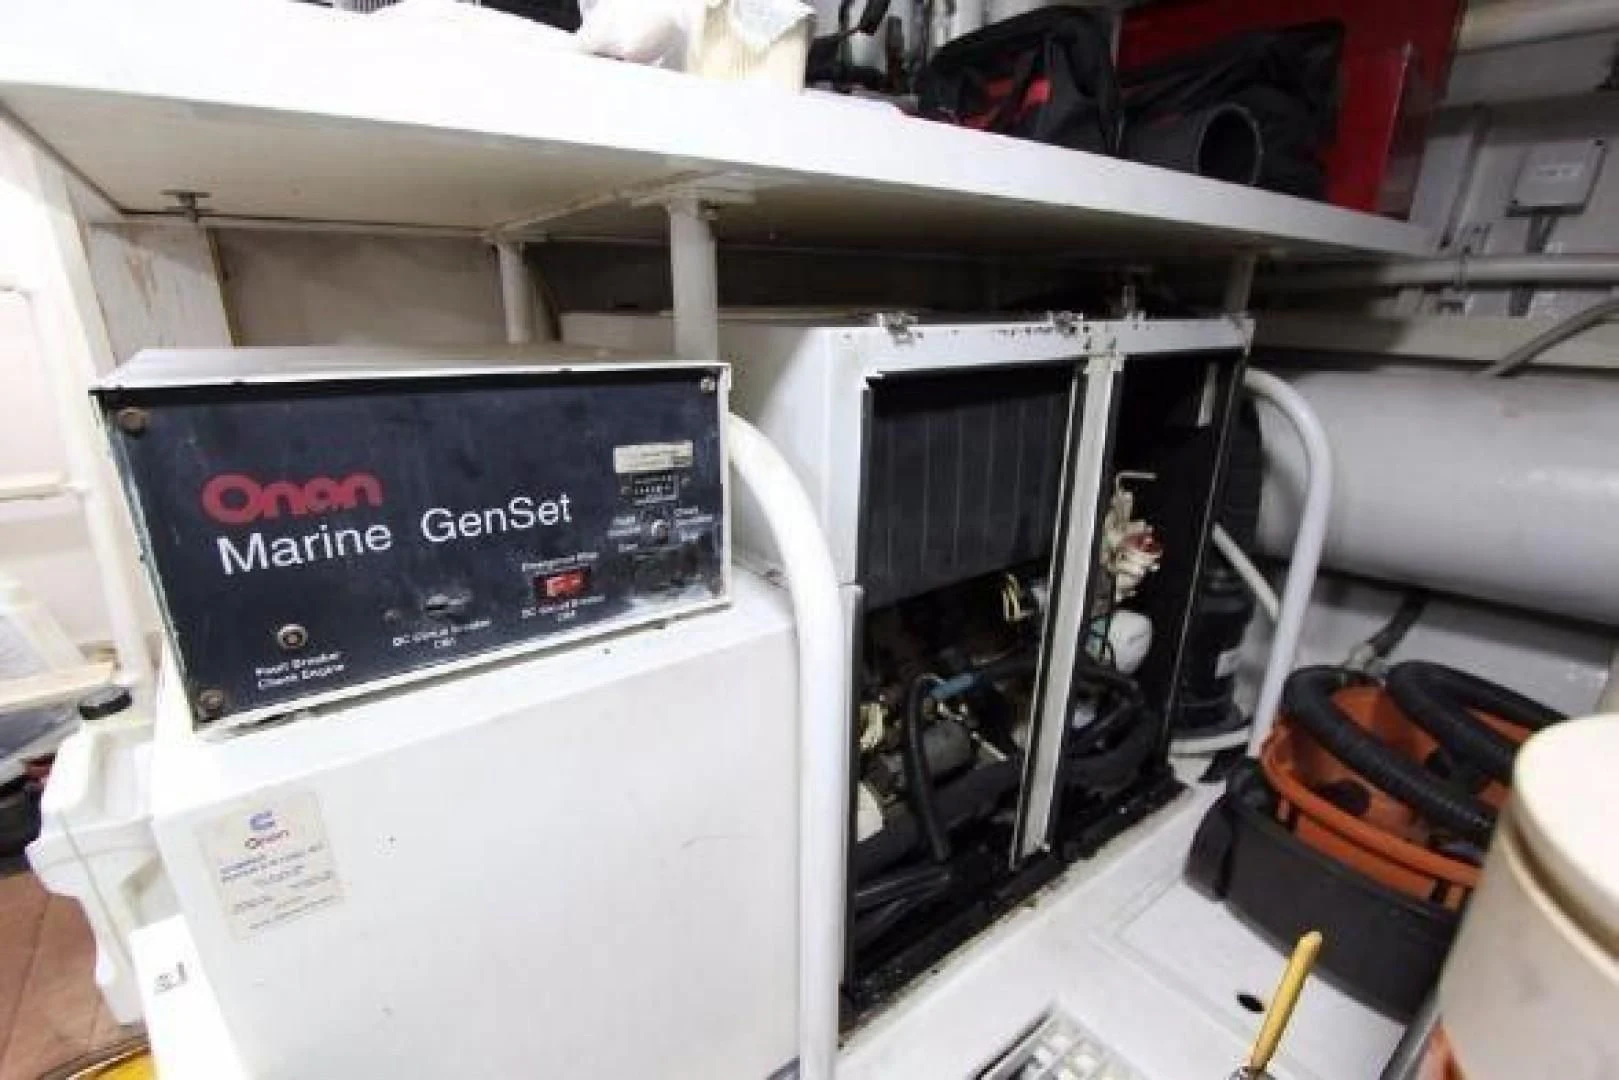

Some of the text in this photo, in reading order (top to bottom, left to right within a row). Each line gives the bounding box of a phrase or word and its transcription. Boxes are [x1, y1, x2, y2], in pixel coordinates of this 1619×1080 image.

[201, 471, 384, 525] Onan
[216, 493, 573, 576] Marine GenSet
